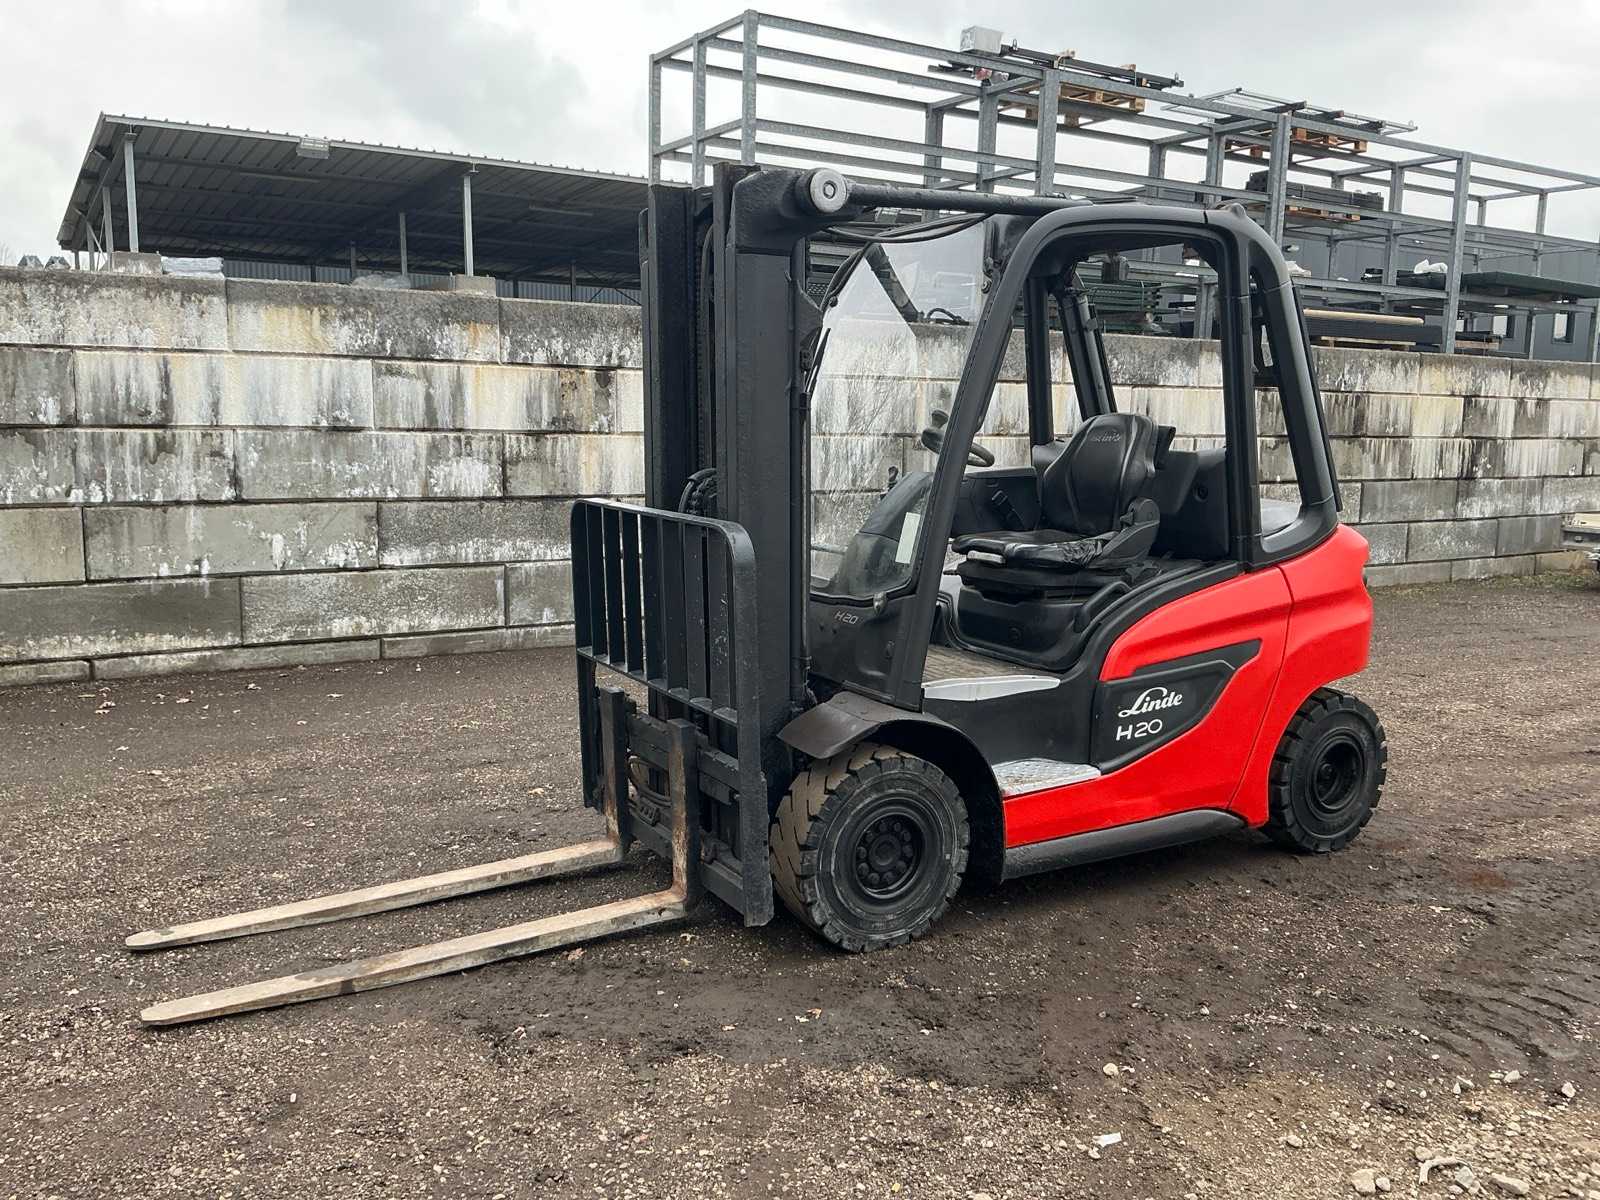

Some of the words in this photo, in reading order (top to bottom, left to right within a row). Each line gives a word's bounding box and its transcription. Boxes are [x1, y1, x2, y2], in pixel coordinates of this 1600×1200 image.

[834, 611, 860, 625] H20
[1118, 686, 1183, 718] Linde
[1115, 718, 1163, 741] H20
